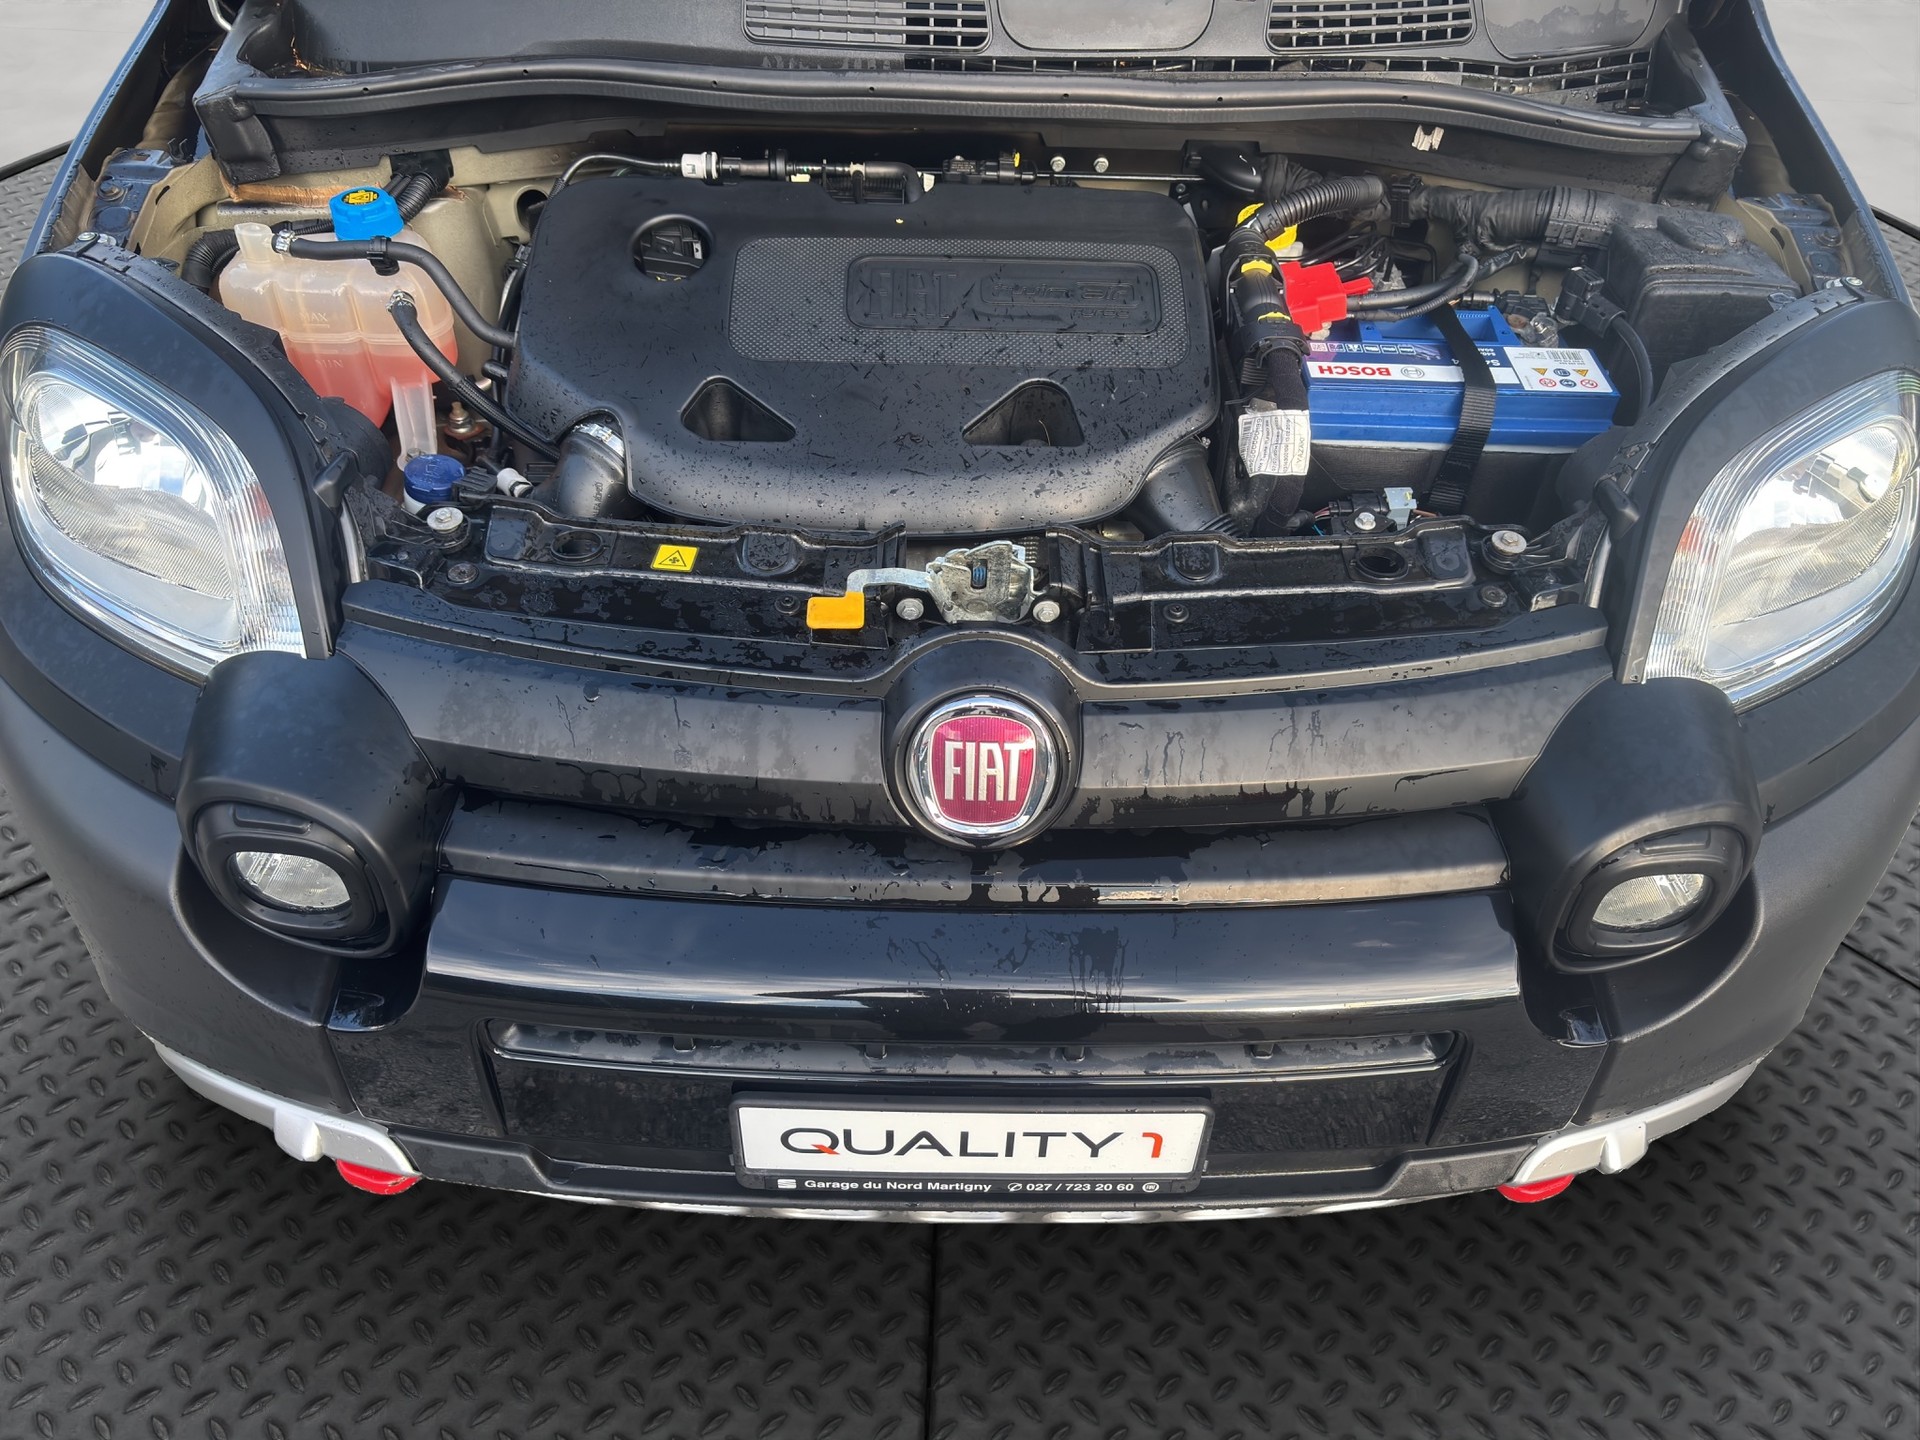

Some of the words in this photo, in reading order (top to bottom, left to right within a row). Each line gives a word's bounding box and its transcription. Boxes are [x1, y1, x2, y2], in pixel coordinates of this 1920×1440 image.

[300, 311, 328, 321] MAX
[1319, 364, 1391, 377] BOSCH
[944, 740, 1035, 802] FIAT
[780, 1127, 1124, 1158] QUALITY
[1142, 1132, 1163, 1158] 1
[804, 1180, 859, 1190] Garage
[863, 1180, 882, 1190] du
[886, 1181, 922, 1190] Nord
[927, 1182, 992, 1193] Martigny
[1026, 1183, 1052, 1191] 027
[1066, 1183, 1091, 1191] 723
[1095, 1183, 1113, 1191] 20
[1116, 1183, 1134, 1191] 60
